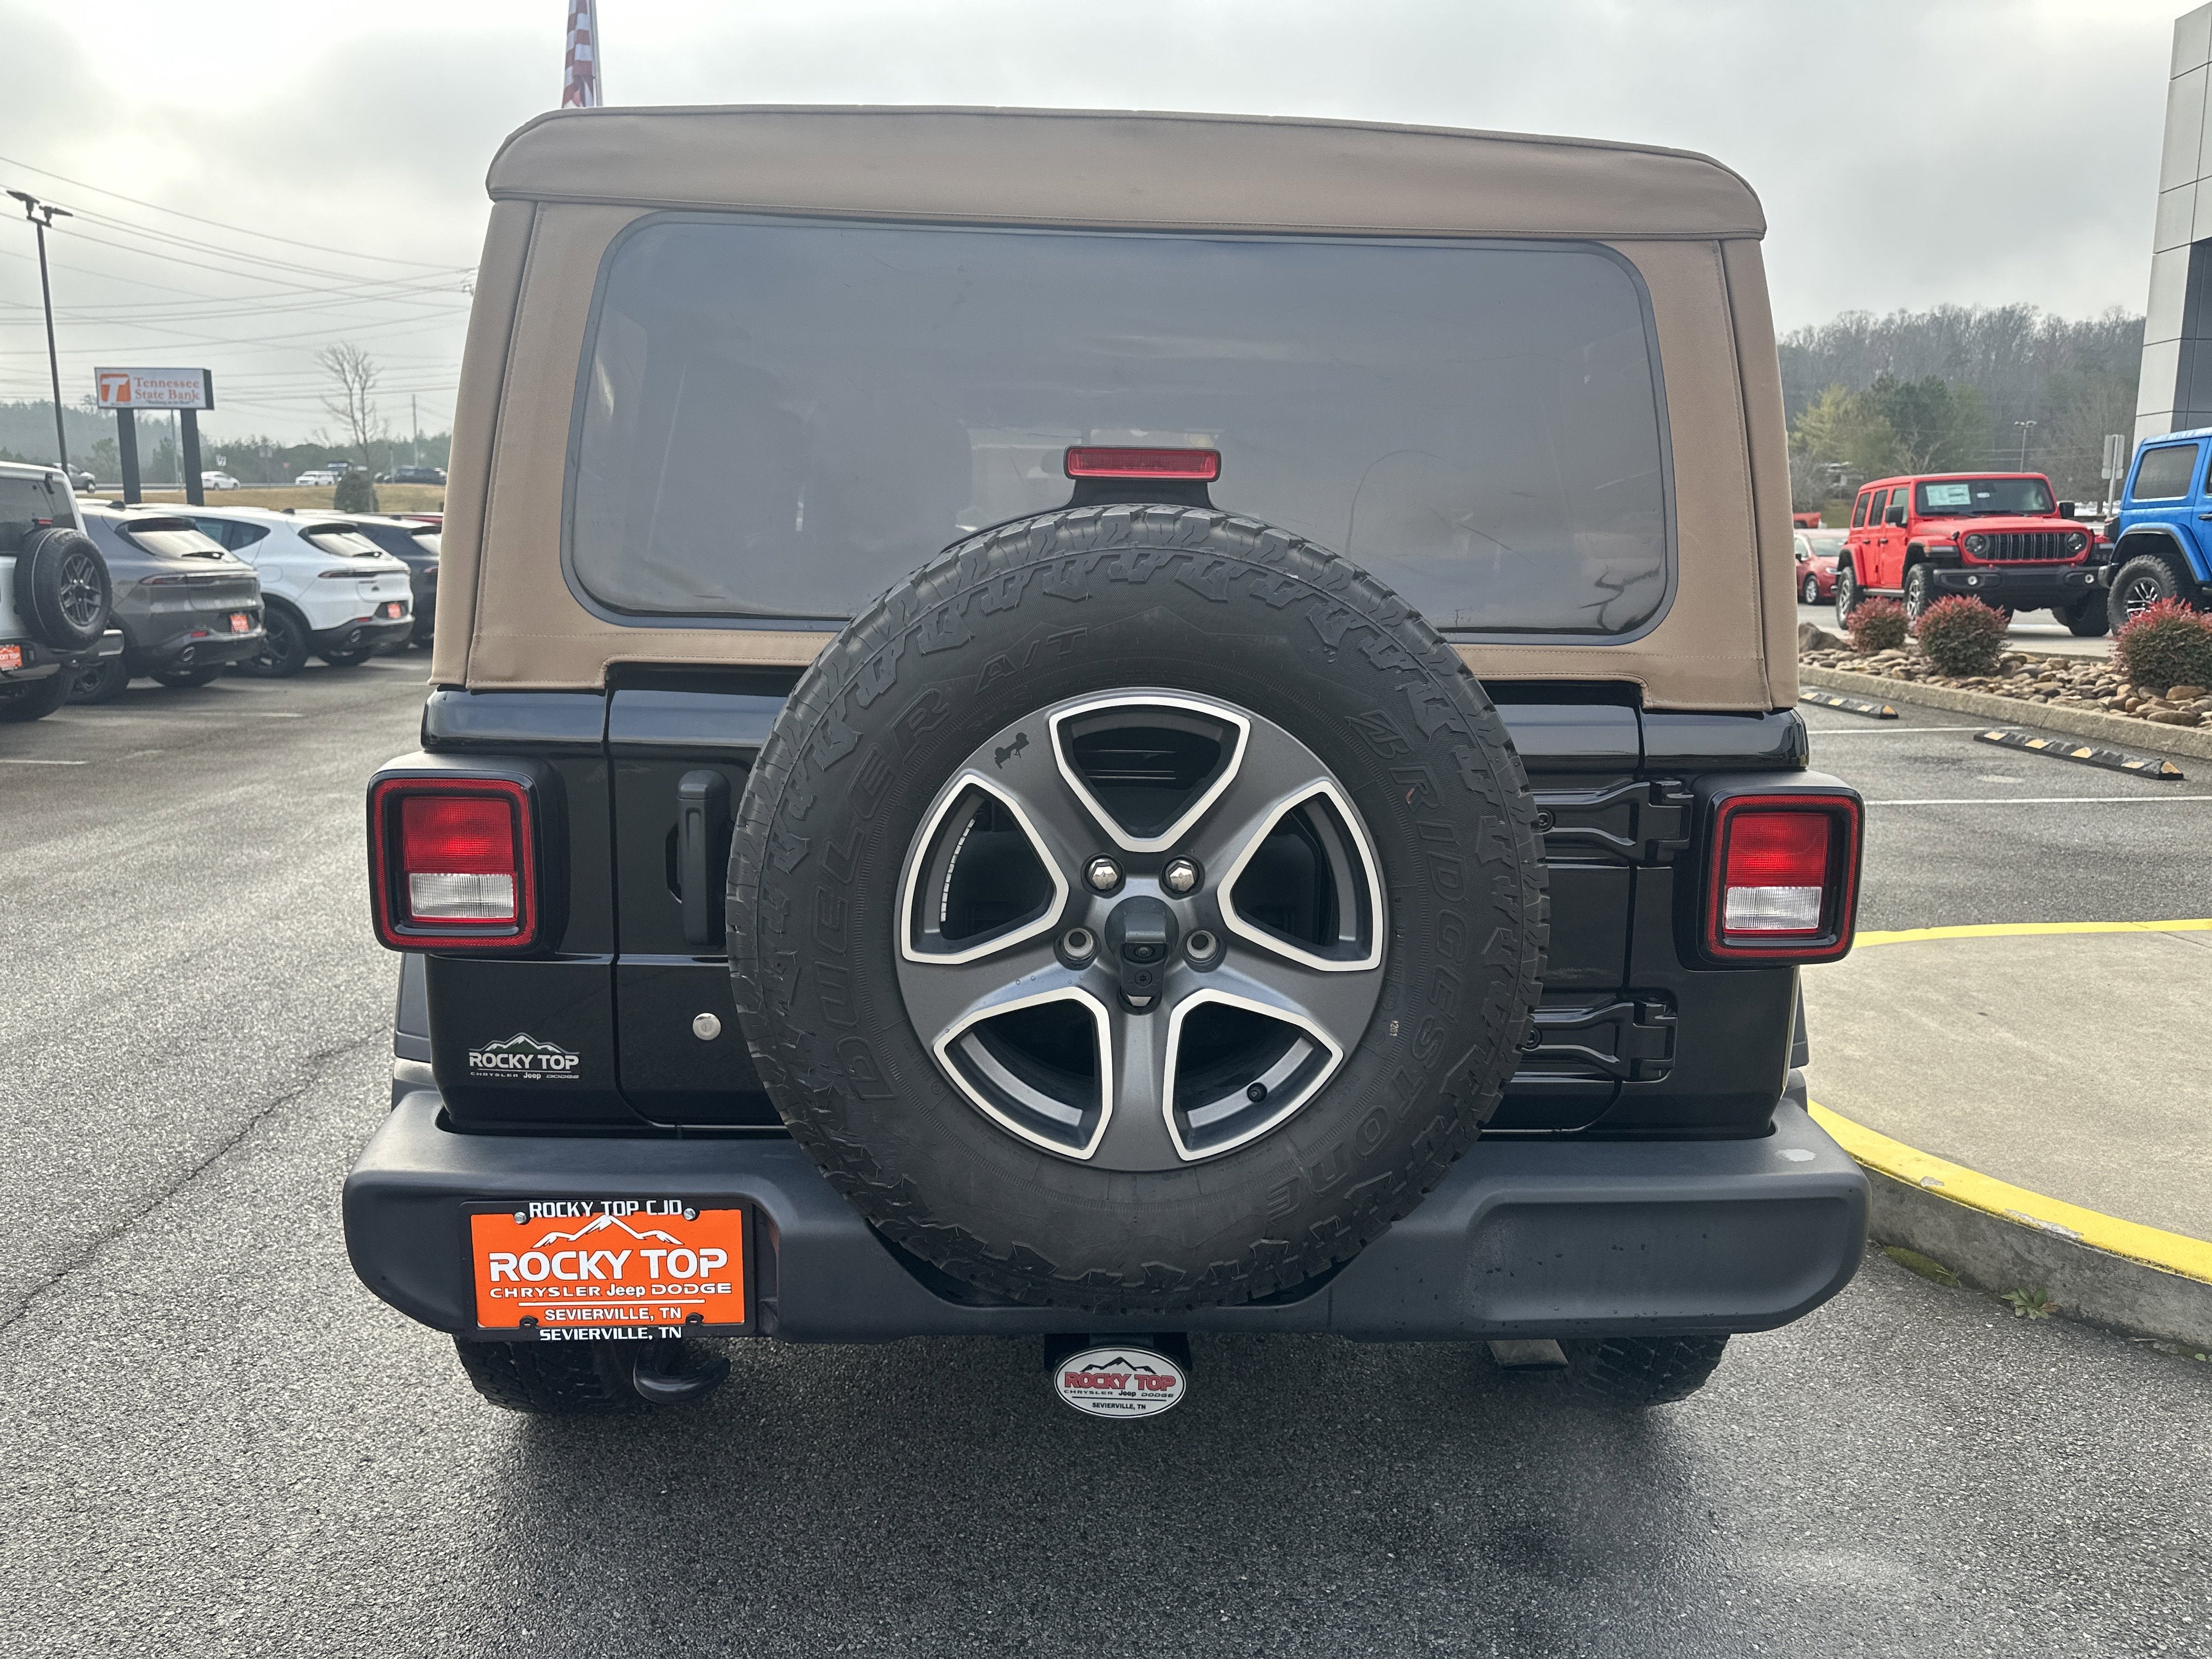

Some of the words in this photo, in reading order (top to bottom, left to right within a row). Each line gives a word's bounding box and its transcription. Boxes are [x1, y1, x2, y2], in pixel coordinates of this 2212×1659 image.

[133, 377, 200, 388] Tennessee
[135, 389, 164, 400] State
[168, 388, 200, 400] Bank
[975, 627, 1089, 693] A/T
[1265, 709, 1467, 1222] BRIDGESTONE
[469, 1052, 534, 1069] ROCKY
[537, 1054, 579, 1070] TOP
[529, 1201, 594, 1218] ROCKY
[601, 1201, 639, 1217] TOP
[646, 1200, 682, 1216] CJD
[488, 1249, 633, 1282] ROCKY
[640, 1248, 729, 1280] TOP
[489, 1284, 601, 1298] CHRYSLER
[606, 1283, 646, 1297] Jeep
[651, 1283, 732, 1295] DODGE
[544, 1307, 654, 1322] SEVIERVILLE,
[659, 1307, 682, 1320] TN
[539, 1328, 653, 1341] SEVIERVILLE,
[658, 1327, 682, 1339] TN
[1064, 1372, 1132, 1389] ROCKY
[1134, 1374, 1176, 1391] TOP
